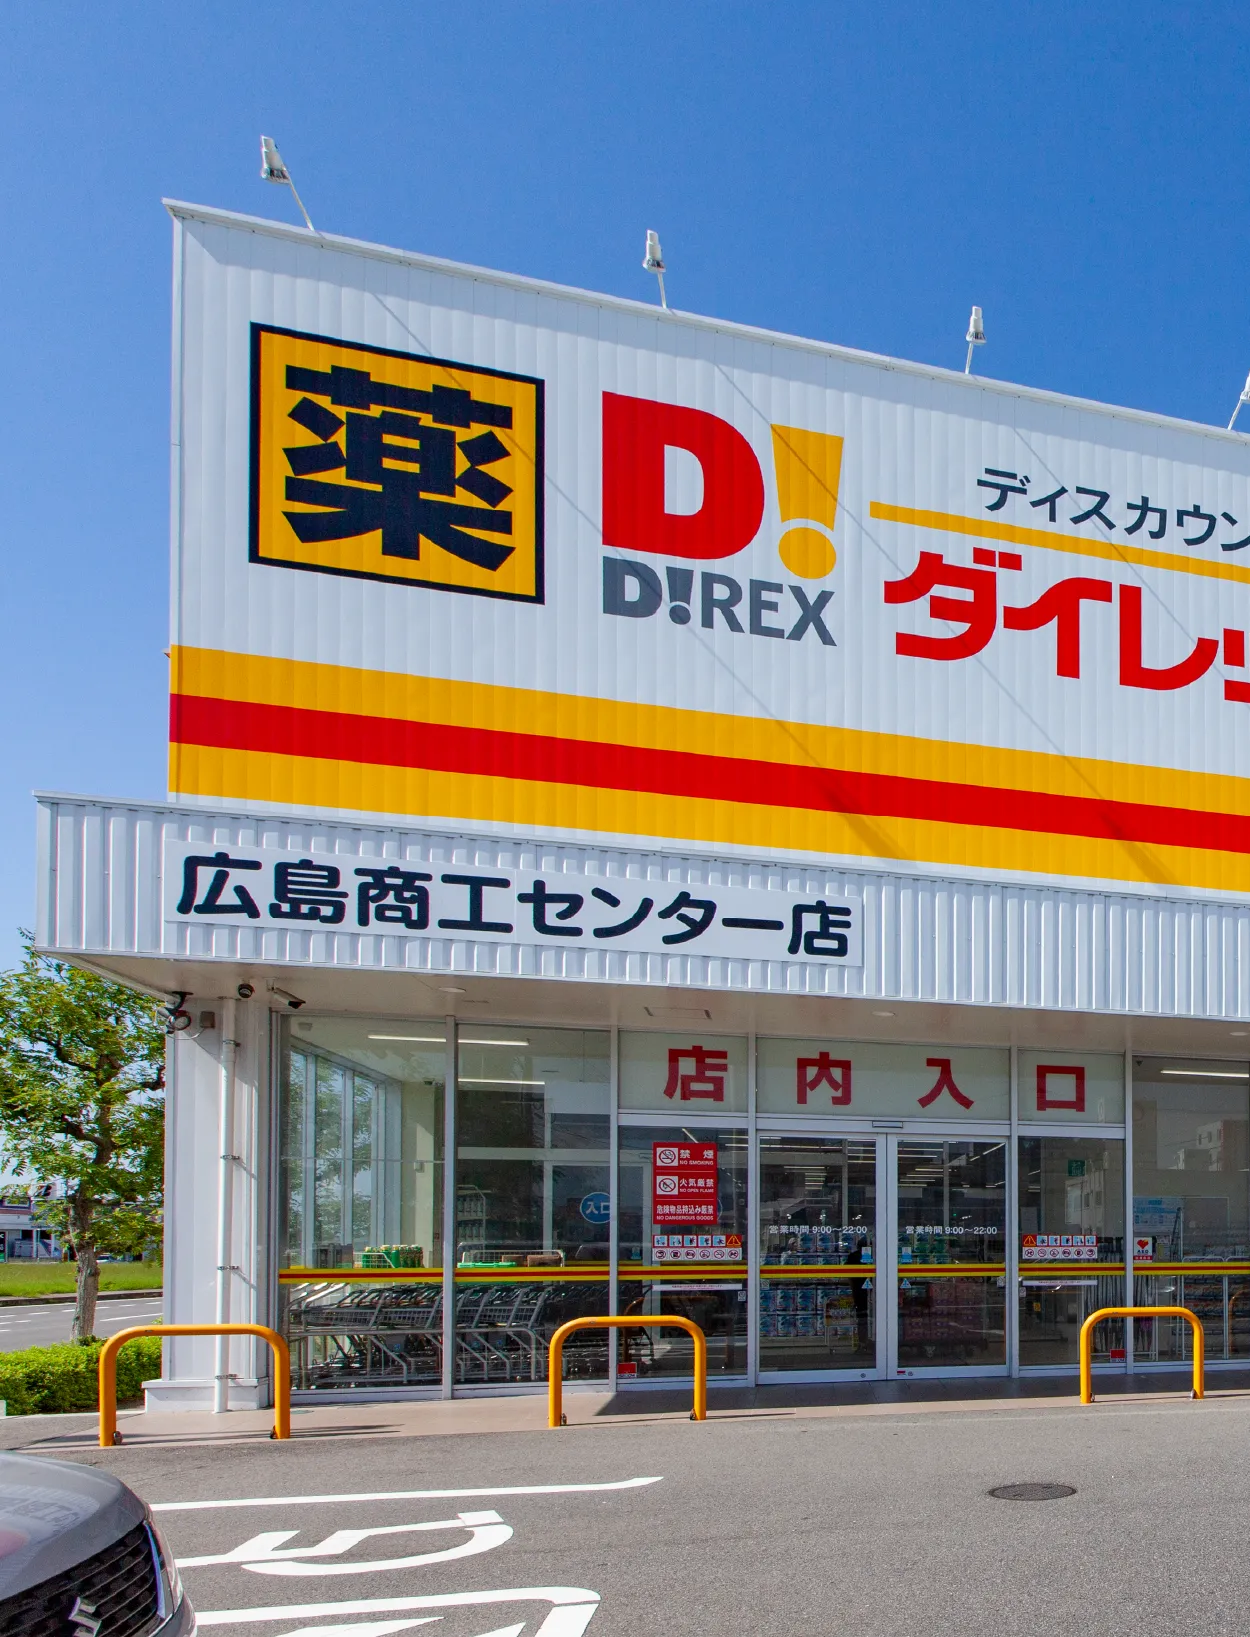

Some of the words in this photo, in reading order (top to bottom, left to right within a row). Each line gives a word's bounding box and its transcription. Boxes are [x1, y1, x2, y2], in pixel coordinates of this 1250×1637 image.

[282, 365, 516, 572] 薬
[176, 852, 853, 958] 広島商工センター店
[663, 1045, 1086, 1113] 店内入口
[679, 1178, 714, 1187] 火気厳禁
[769, 1225, 810, 1234] 営業時間
[905, 1225, 943, 1235] 営業時間
